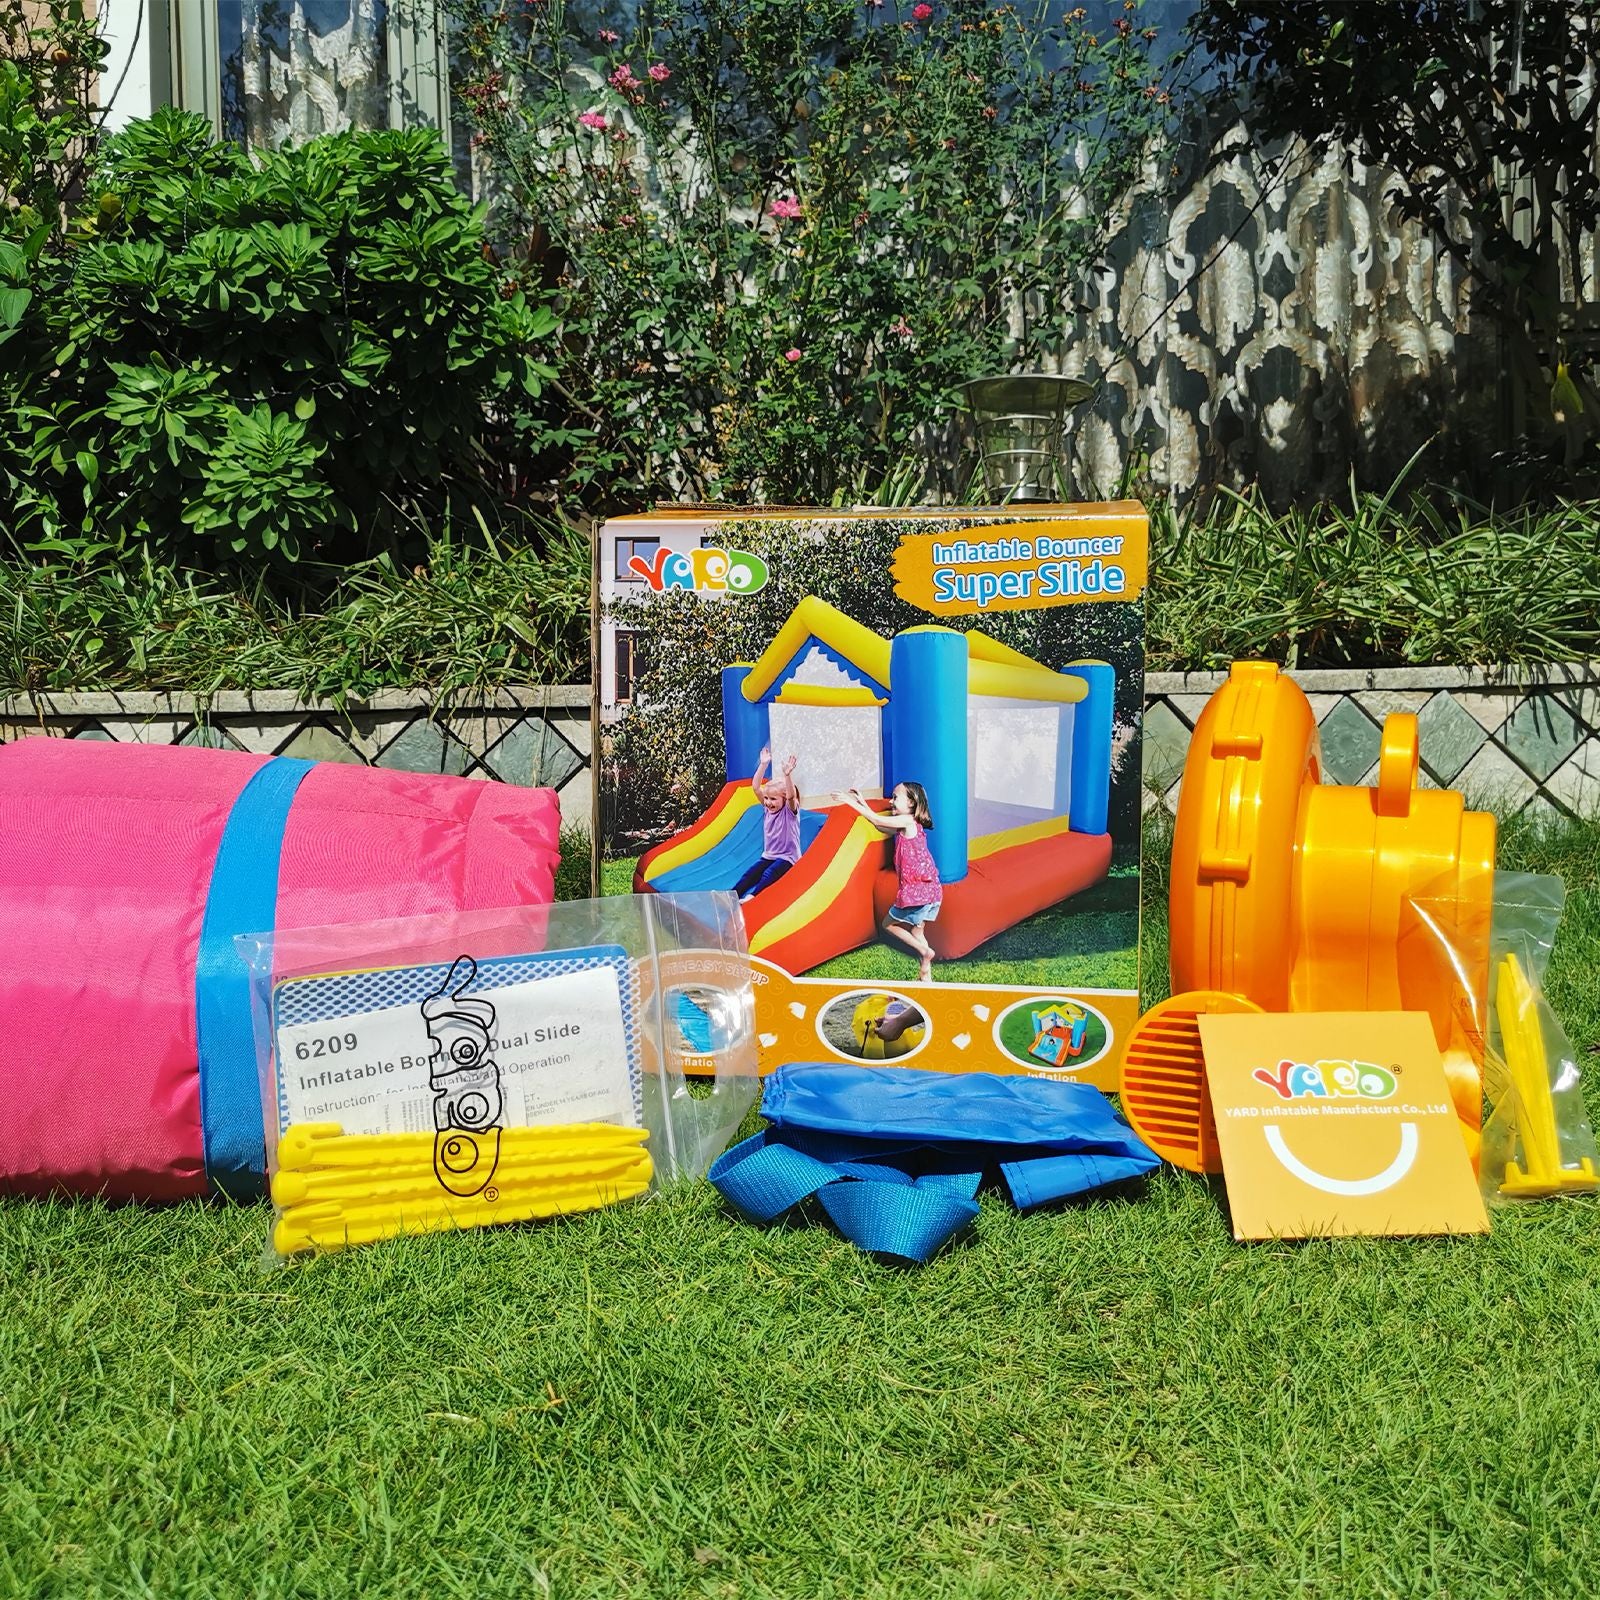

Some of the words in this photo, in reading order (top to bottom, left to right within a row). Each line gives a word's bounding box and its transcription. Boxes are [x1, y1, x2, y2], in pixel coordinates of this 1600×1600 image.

[933, 537, 1032, 565] Inflatable
[1035, 535, 1124, 559] Bouncer
[627, 547, 769, 595] YARD
[932, 568, 1035, 607] Super
[1037, 560, 1125, 596] Slide
[295, 1032, 358, 1060] 6209
[299, 1061, 394, 1090] Inflatable
[488, 1032, 529, 1052] Dual
[534, 1023, 580, 1042] Slide
[509, 1054, 571, 1073] Operation
[1252, 1059, 1398, 1100] YARD
[1225, 1107, 1258, 1117] YARD
[1261, 1105, 1319, 1116] Inflatable
[1322, 1104, 1400, 1115] Manufacture
[1402, 1104, 1426, 1115] Co.,
[1427, 1103, 1448, 1114] Ltd
